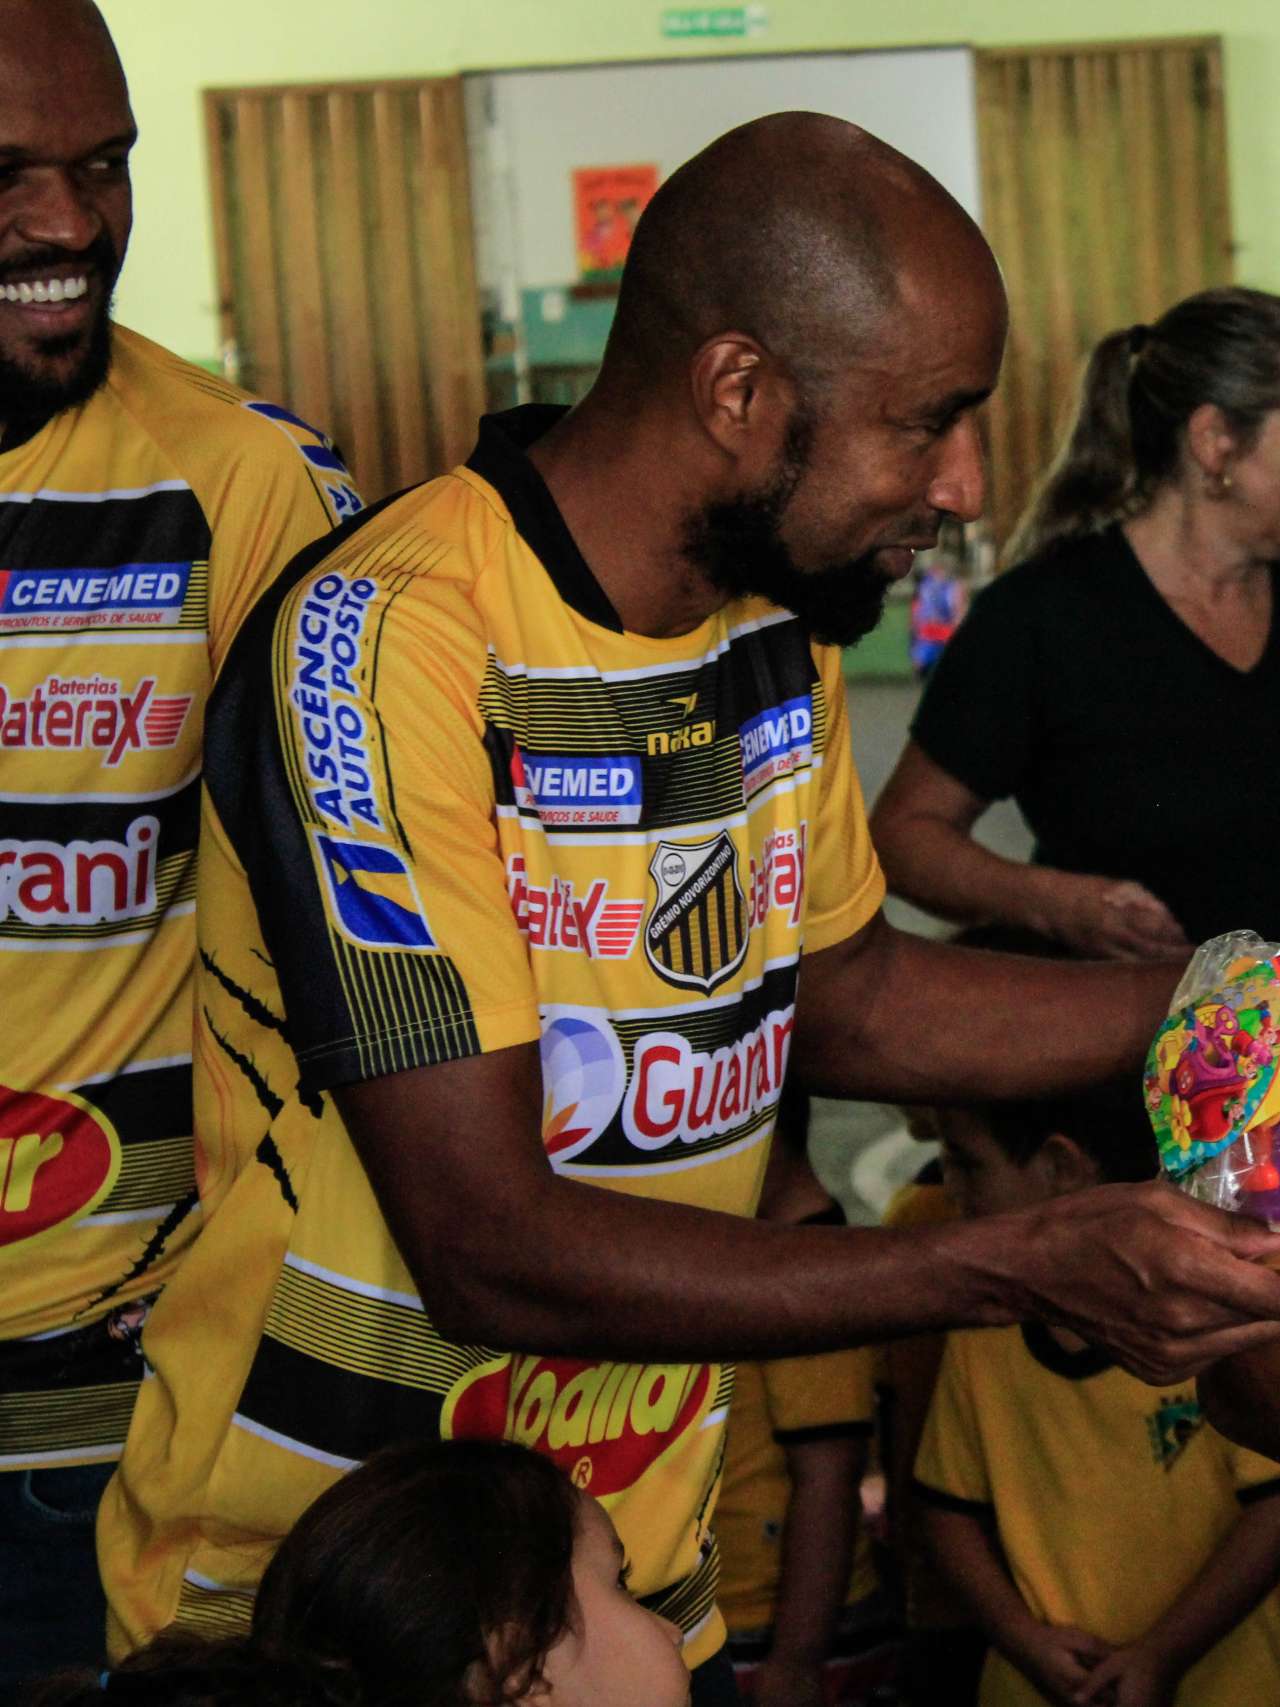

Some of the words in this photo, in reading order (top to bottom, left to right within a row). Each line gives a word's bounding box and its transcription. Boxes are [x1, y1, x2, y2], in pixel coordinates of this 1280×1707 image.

[12, 573, 181, 607] CENEMED
[331, 579, 375, 694] POSTO
[49, 677, 118, 696] Baterias
[294, 574, 349, 827] ASCÊNCIO
[335, 704, 380, 826] AUTO
[678, 844, 733, 910] NOVORIZONTINO
